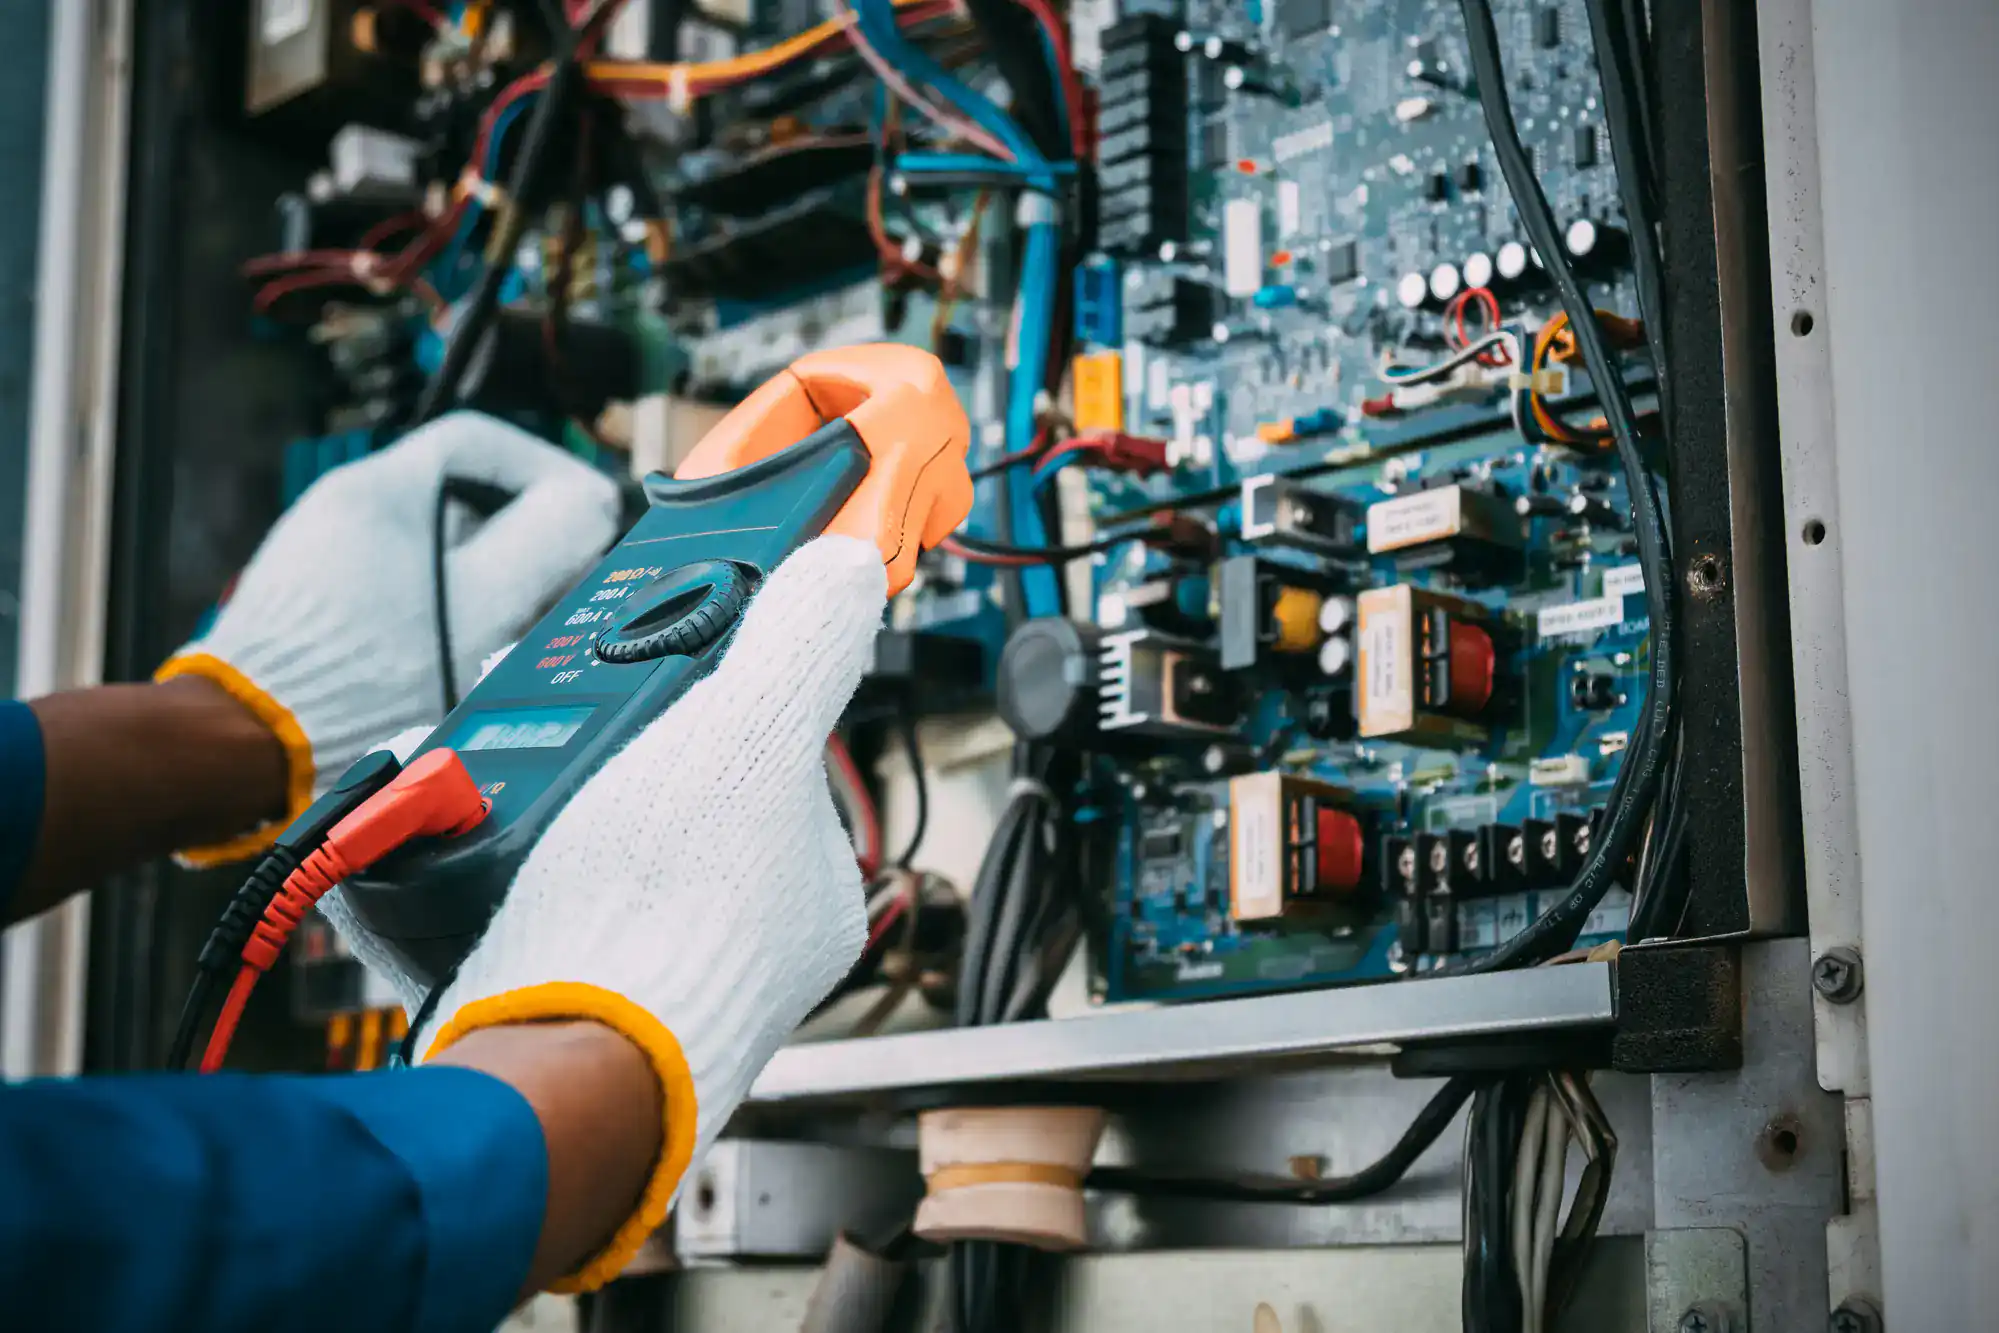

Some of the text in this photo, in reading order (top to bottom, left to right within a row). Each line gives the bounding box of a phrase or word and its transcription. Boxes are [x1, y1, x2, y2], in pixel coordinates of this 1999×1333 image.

[589, 586, 628, 602] 200A
[565, 610, 603, 626] 600A
[545, 635, 584, 649] 200V
[536, 653, 576, 669] 600V
[550, 669, 584, 684] OFF
